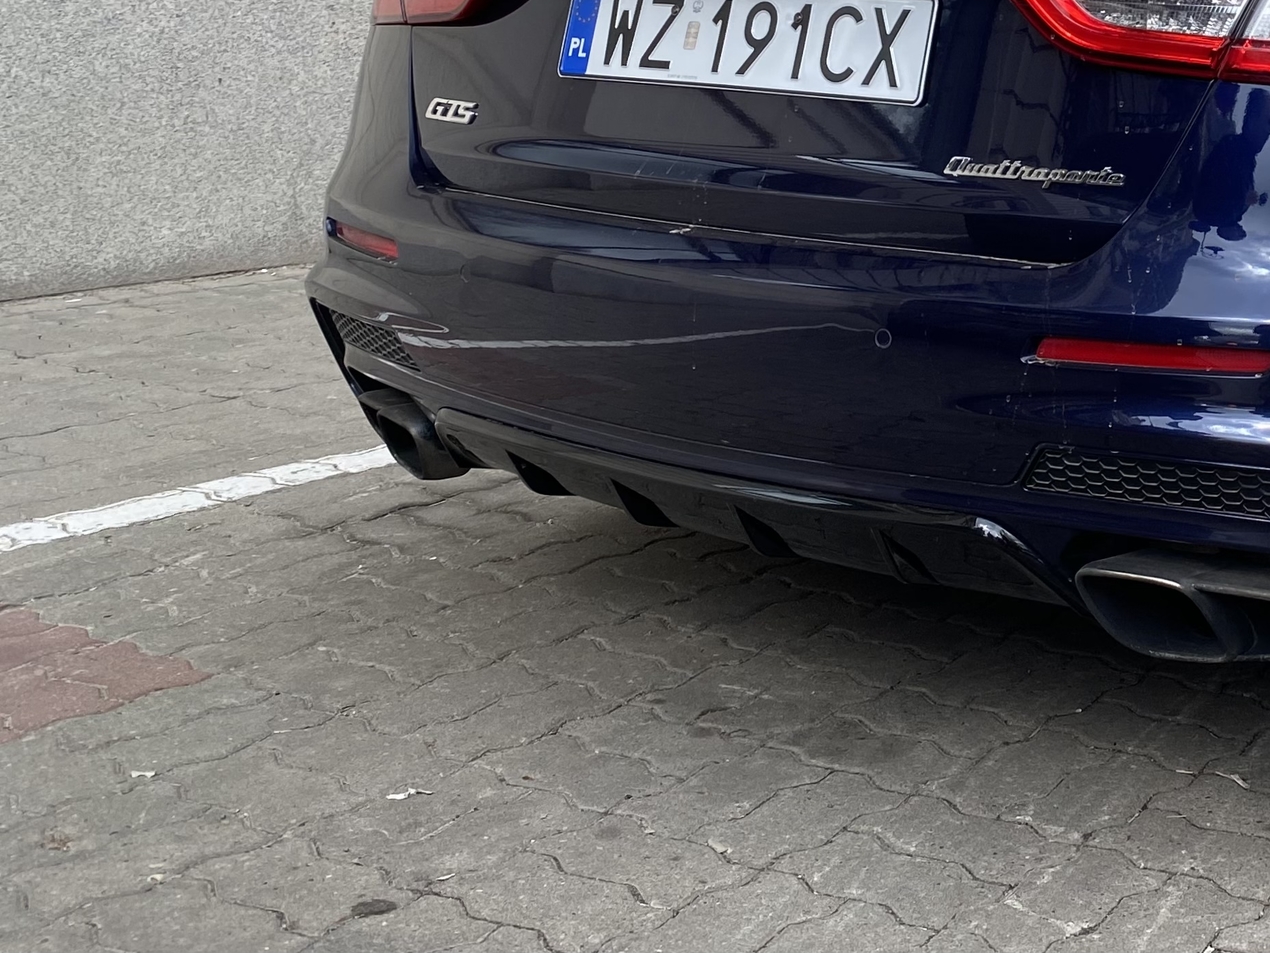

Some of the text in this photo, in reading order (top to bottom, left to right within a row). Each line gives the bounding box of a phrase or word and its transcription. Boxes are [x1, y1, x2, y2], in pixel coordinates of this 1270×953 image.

[567, 37, 587, 58] PL
[425, 97, 479, 125] GTS
[943, 155, 1127, 189] Quattroporte
